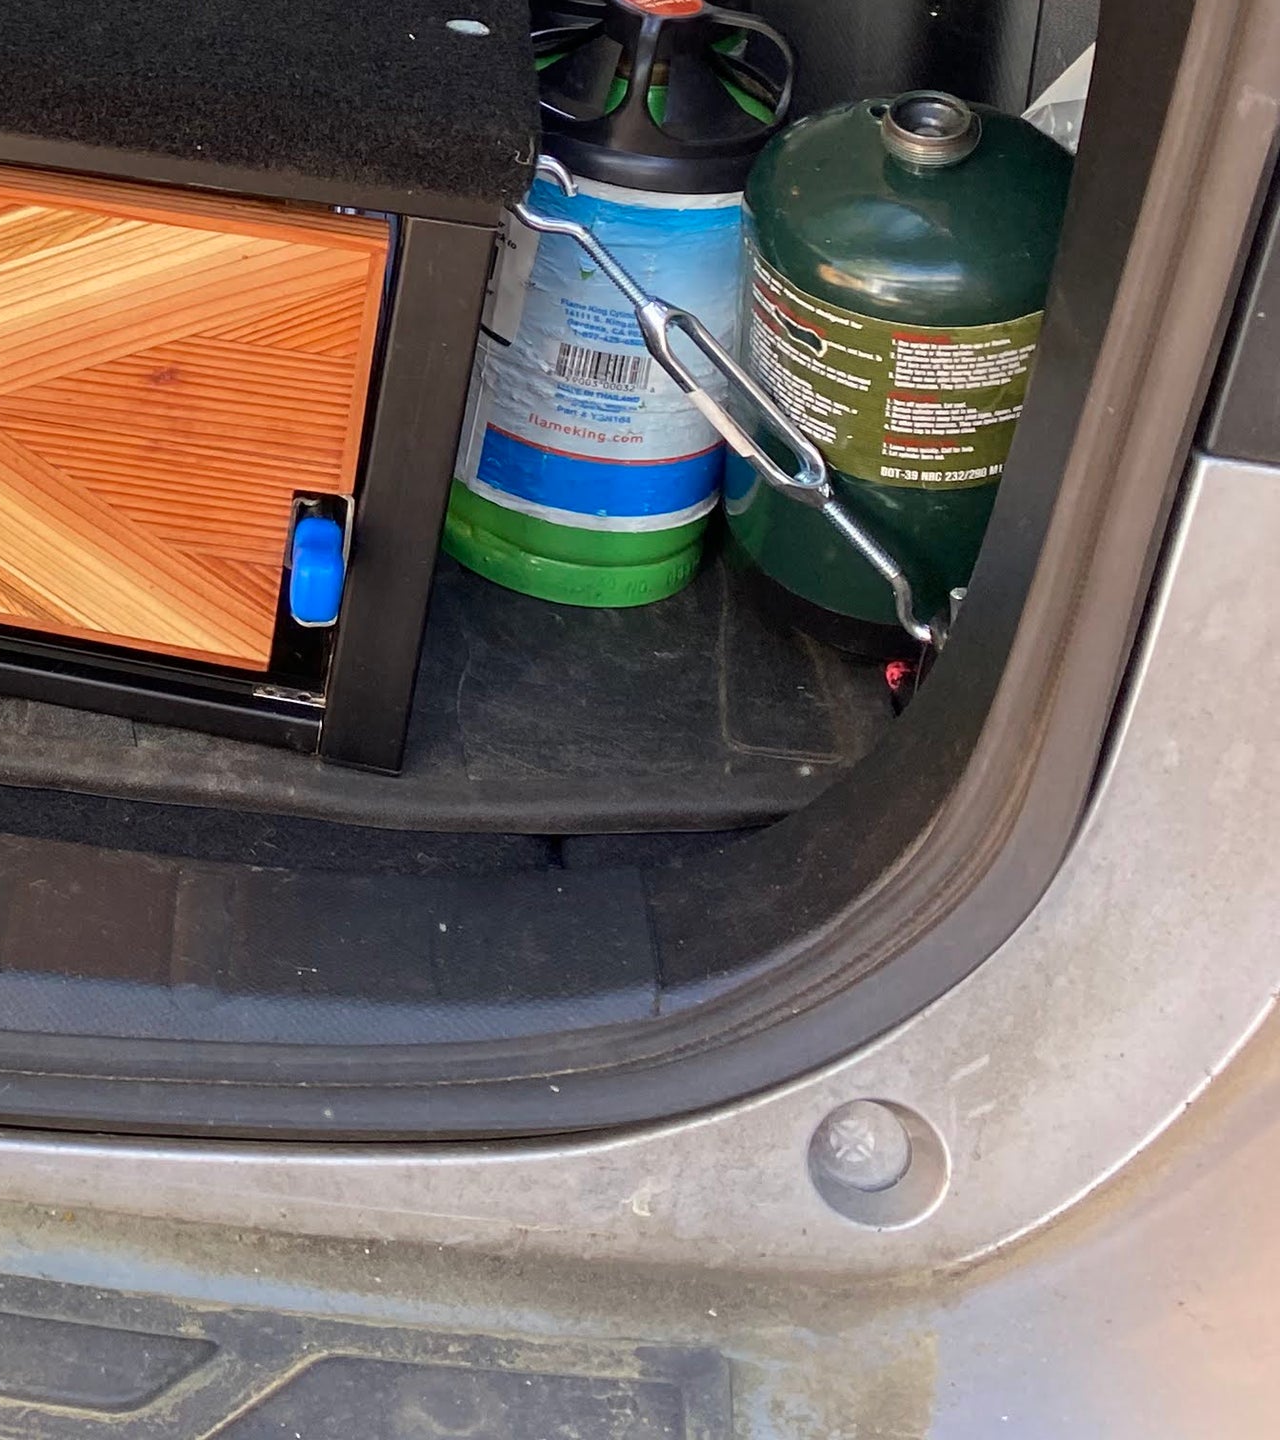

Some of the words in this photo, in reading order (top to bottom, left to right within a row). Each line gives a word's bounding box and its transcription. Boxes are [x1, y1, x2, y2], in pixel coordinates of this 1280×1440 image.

[560, 298, 587, 310] Flame
[528, 413, 643, 444] flameking.com
[880, 466, 918, 480] DOT-39
[921, 471, 943, 482] NRC
